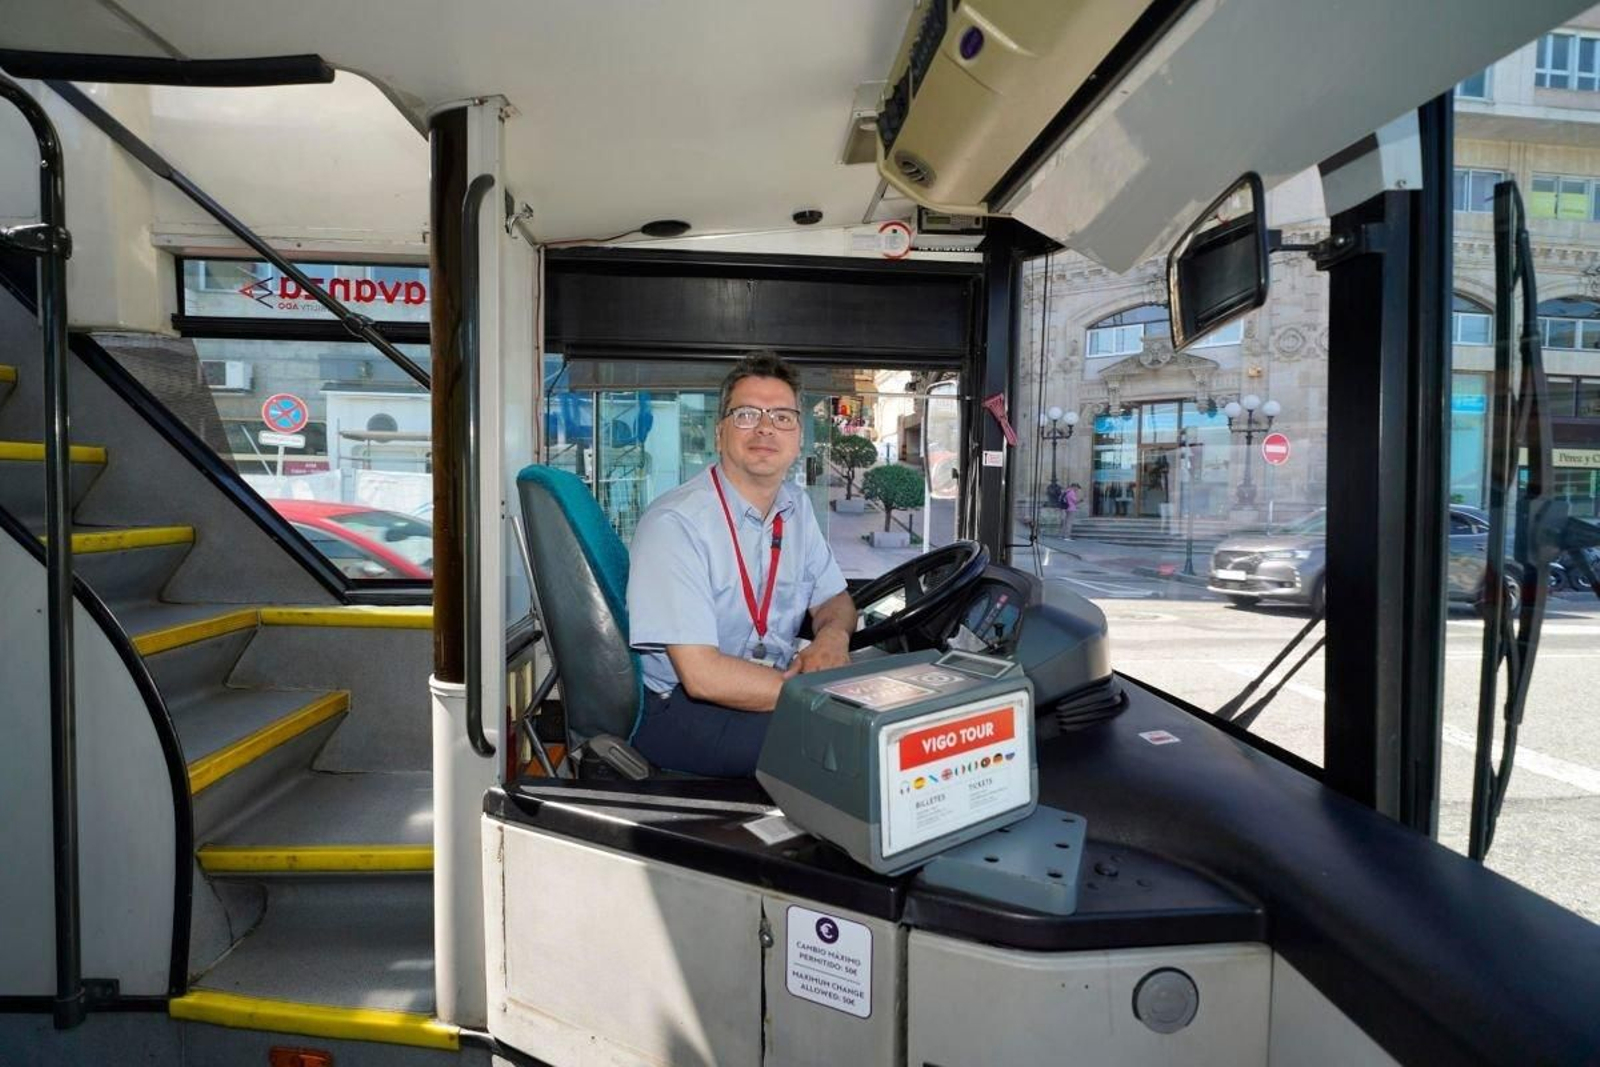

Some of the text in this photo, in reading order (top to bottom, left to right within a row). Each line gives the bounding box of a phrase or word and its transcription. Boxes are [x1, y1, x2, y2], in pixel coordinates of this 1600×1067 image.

[922, 722, 994, 754] VIGO TOUR
[968, 778, 993, 790] TICKETS
[915, 793, 946, 809] BILLETES
[796, 941, 826, 956] CAMBIO
[799, 953, 843, 971] PERMITIDO:
[792, 971, 864, 999] MAXIMUM CHANGE
[800, 983, 841, 1000] ALLOWED:
